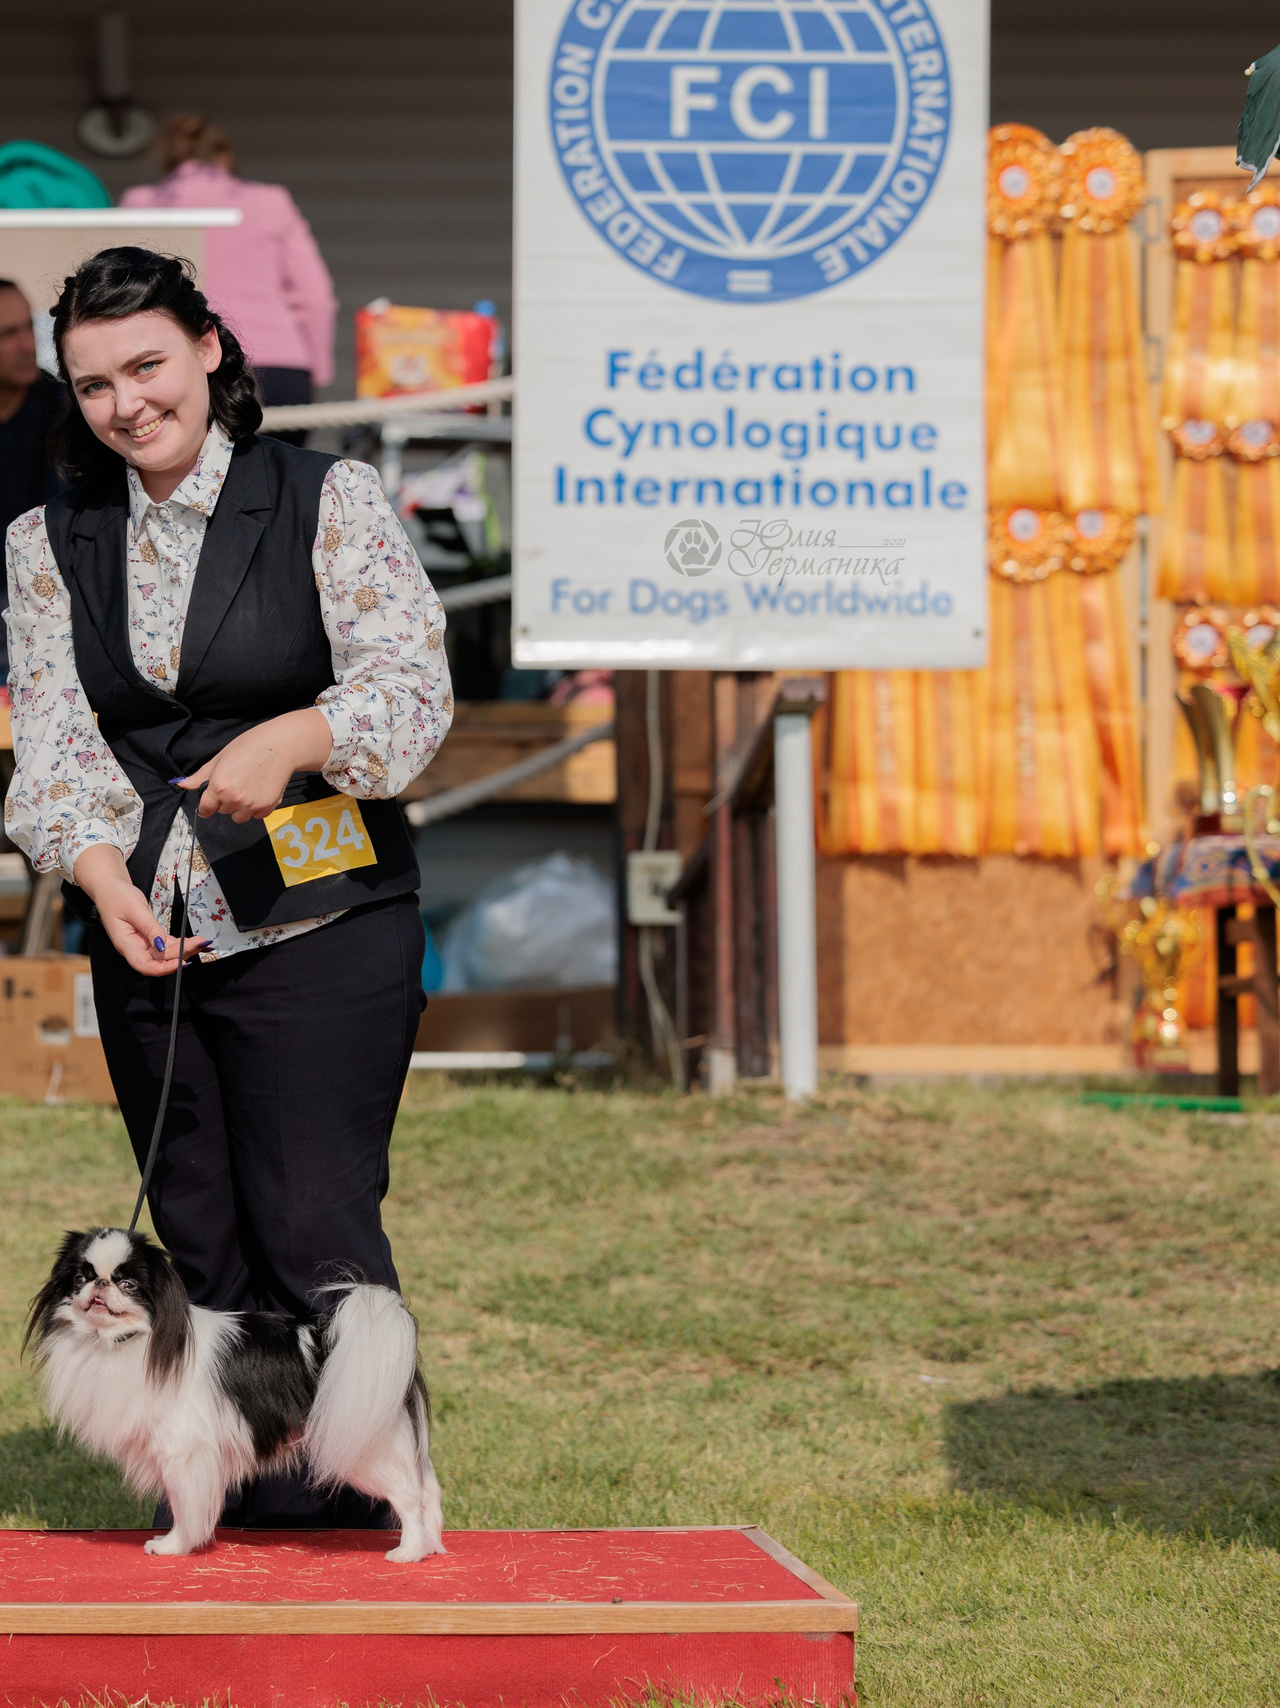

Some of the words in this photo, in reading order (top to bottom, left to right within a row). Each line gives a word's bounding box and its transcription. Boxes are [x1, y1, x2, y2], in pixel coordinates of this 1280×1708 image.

[670, 65, 828, 140] FCI
[814, 0, 948, 282] TERNATIONALE
[606, 348, 916, 394] Fédération
[582, 406, 939, 461] Cynologique
[554, 465, 969, 509] Internationale
[551, 578, 612, 615] For
[629, 578, 730, 623] Dogs
[743, 580, 954, 617] Worldwide
[276, 809, 365, 868] 324
